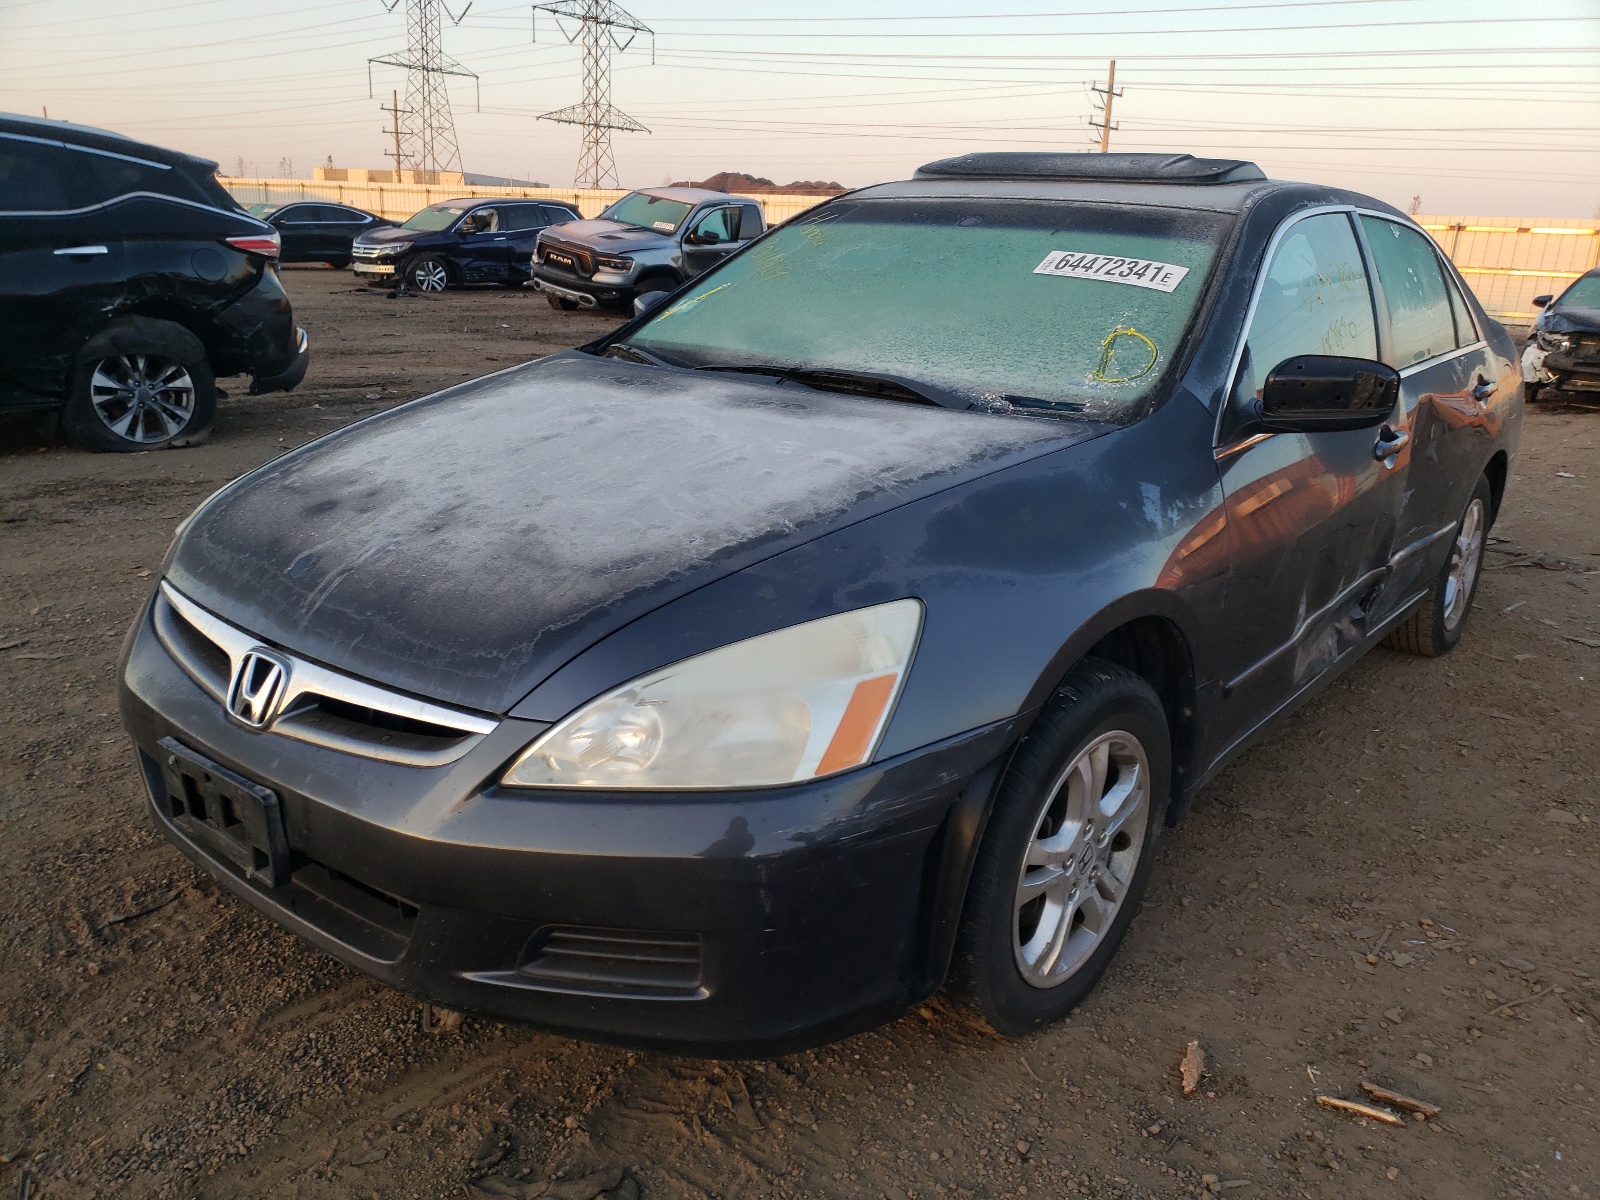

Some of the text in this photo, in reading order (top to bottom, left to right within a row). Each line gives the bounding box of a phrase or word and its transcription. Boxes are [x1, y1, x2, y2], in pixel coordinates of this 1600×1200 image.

[550, 253, 571, 265] RAM
[1054, 253, 1165, 283] 64472341
[1160, 272, 1174, 283] E
